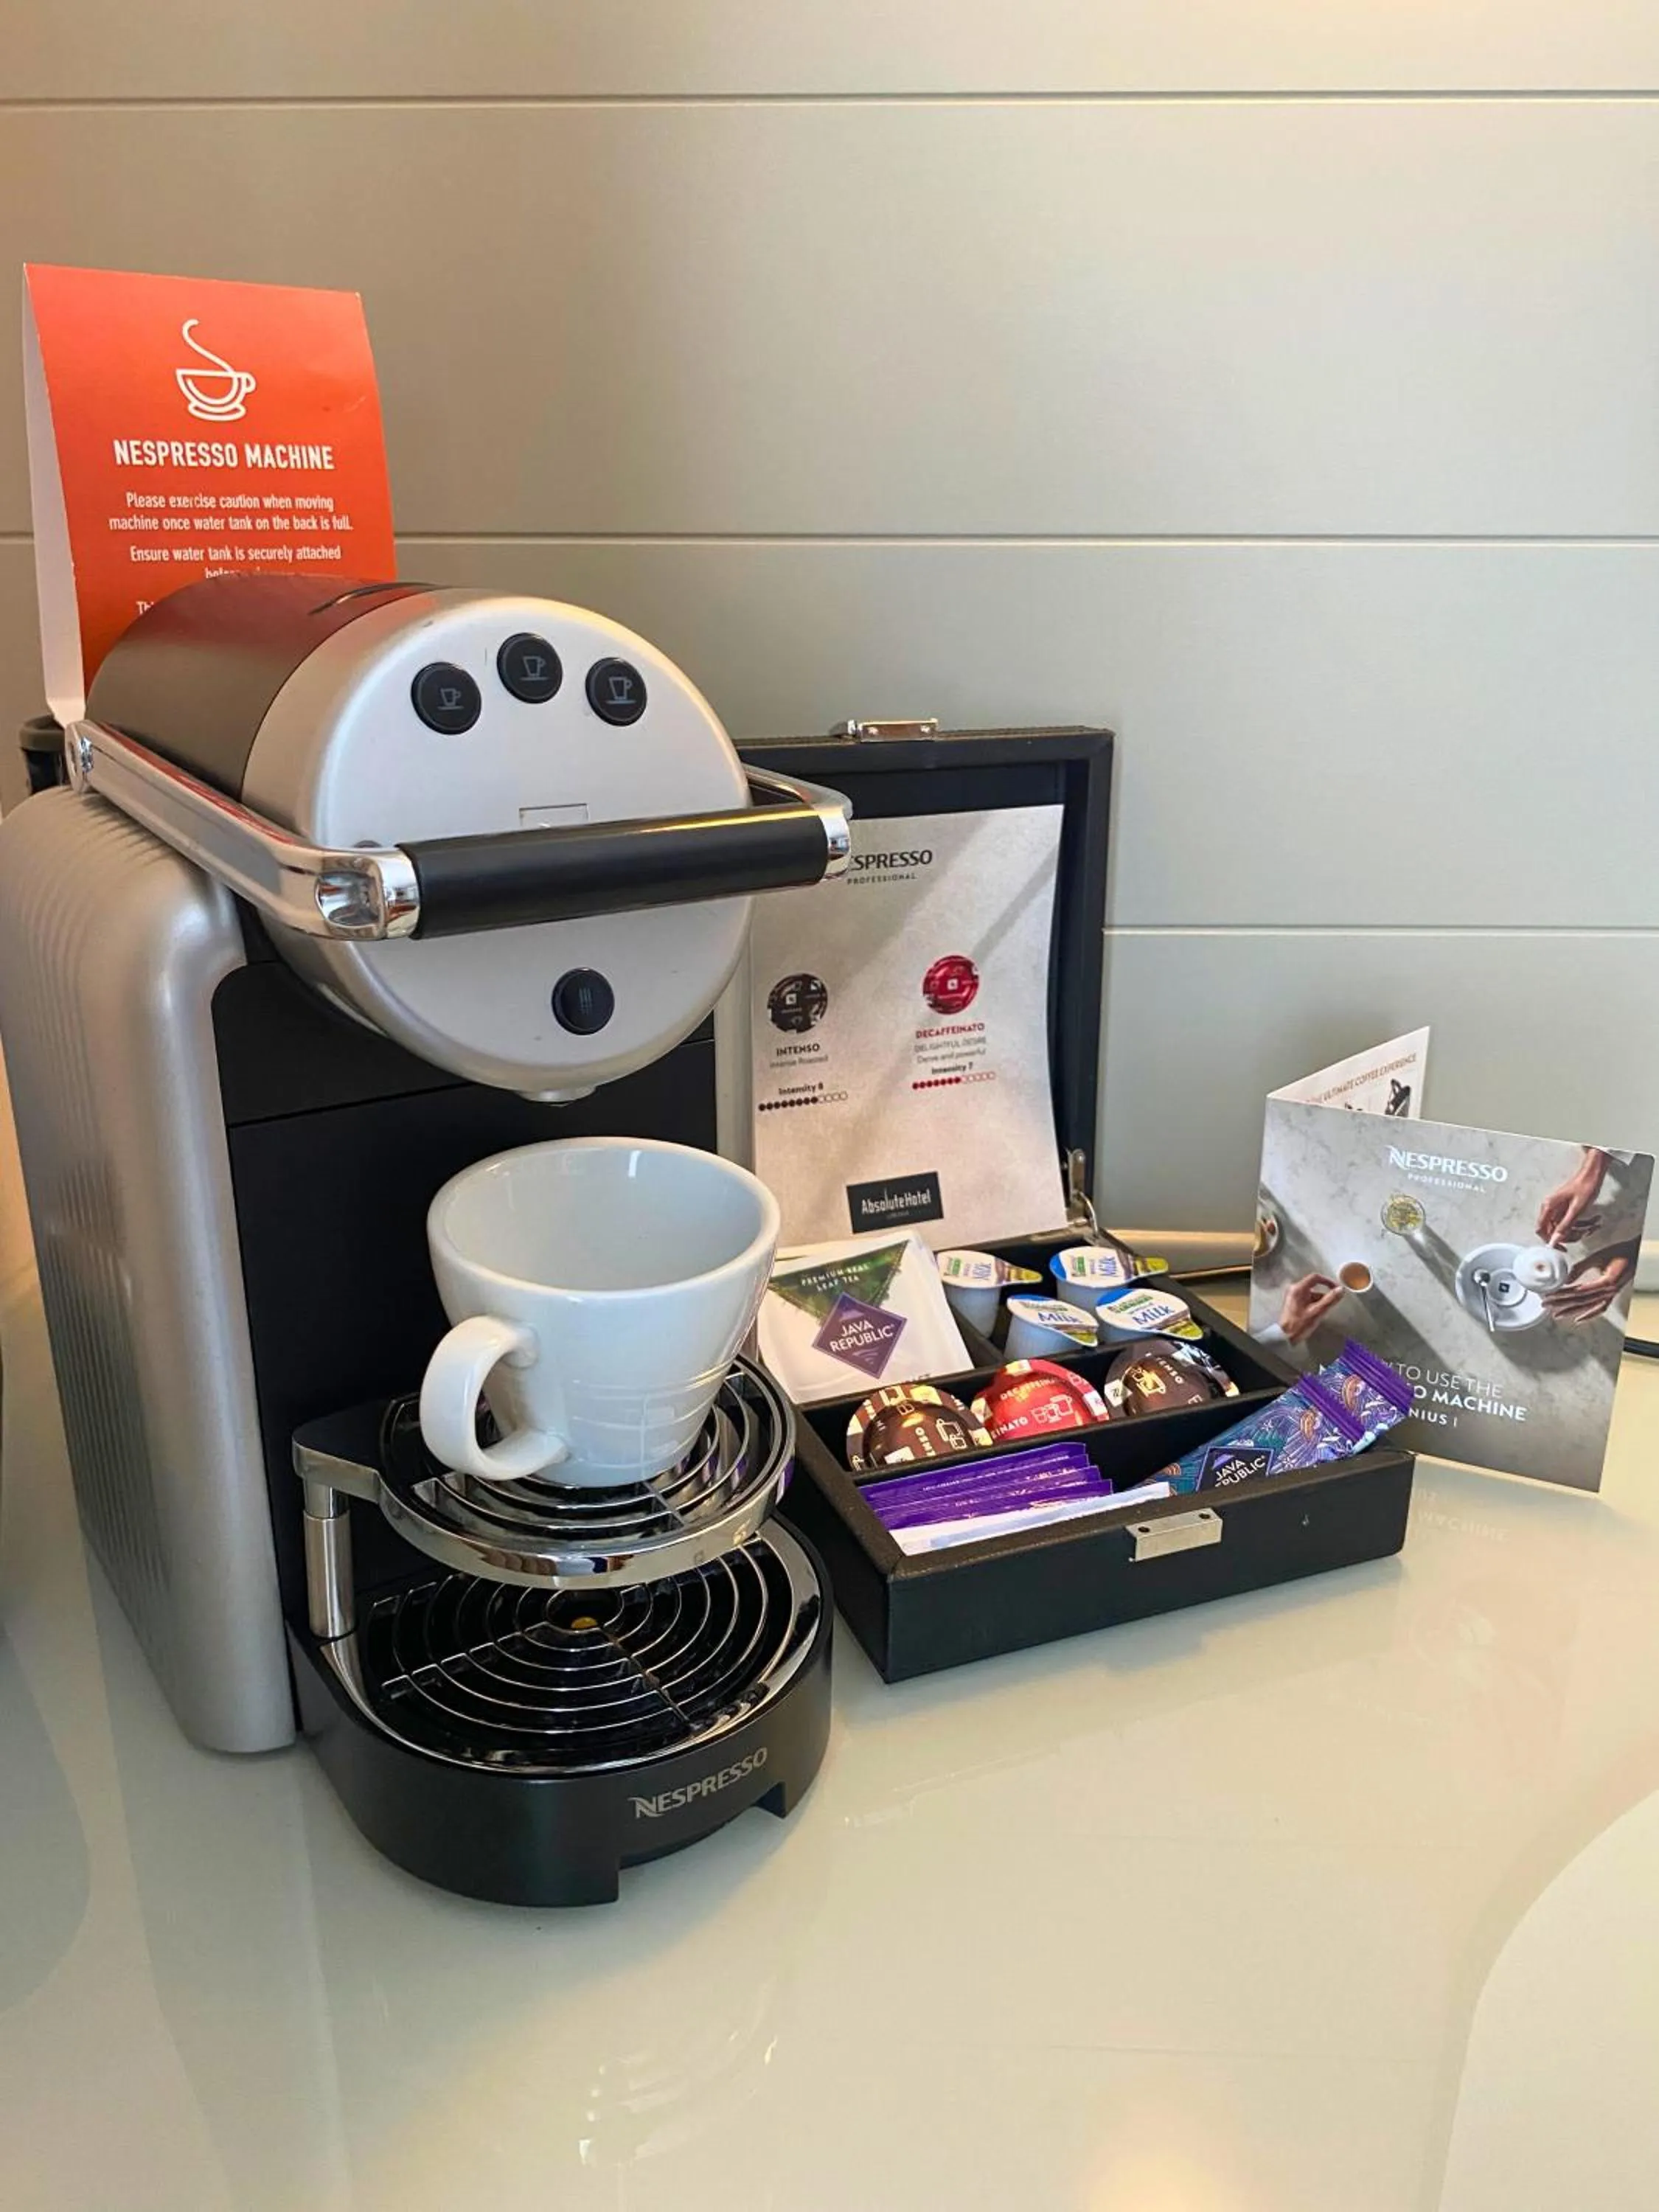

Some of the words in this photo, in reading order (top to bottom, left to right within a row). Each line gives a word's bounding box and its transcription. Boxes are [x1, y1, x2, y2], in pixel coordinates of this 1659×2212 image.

[113, 439, 238, 468] NESPRESSO
[244, 442, 335, 470] MACHINE
[125, 491, 166, 508] Please
[169, 493, 217, 509] exercise
[219, 494, 260, 509] caution
[262, 494, 293, 509] when
[296, 495, 334, 513] moving
[109, 514, 159, 530] machine
[162, 518, 190, 530] once
[193, 516, 225, 530] water
[229, 515, 252, 530] tank
[255, 518, 270, 530] on
[272, 515, 290, 530] the
[293, 515, 318, 530] back
[320, 516, 330, 530] is
[130, 545, 170, 562] Ensure
[172, 546, 204, 561] water
[207, 546, 232, 561] tank
[234, 546, 246, 561] is
[248, 545, 293, 564] securely
[296, 545, 342, 560] attached
[851, 849, 933, 871] SPRESSO
[846, 872, 918, 886] PROFESSIONAL
[915, 1023, 985, 1040] DECAFFEINATO
[776, 1043, 820, 1057] INTENSO
[1385, 1144, 1508, 1183] NESPRESSO
[1407, 1172, 1487, 1194] PROFESSIONAL
[801, 1268, 845, 1287] PREMIUM
[816, 1278, 839, 1292] LEAF
[842, 1274, 860, 1284] TEA
[1132, 1304, 1175, 1325] Milk
[830, 1324, 894, 1352] REPUBLIC
[841, 1318, 874, 1338] JAVA
[1395, 1363, 1421, 1381] TO
[1427, 1369, 1461, 1390] USE
[1464, 1377, 1504, 1399] THE
[1408, 1408, 1448, 1425] NIUS
[1431, 1391, 1528, 1422] MACHINE
[1214, 1457, 1266, 1487] PUBLIC
[1215, 1459, 1245, 1481] JAVA
[627, 1747, 768, 1820] NESPRESSO
